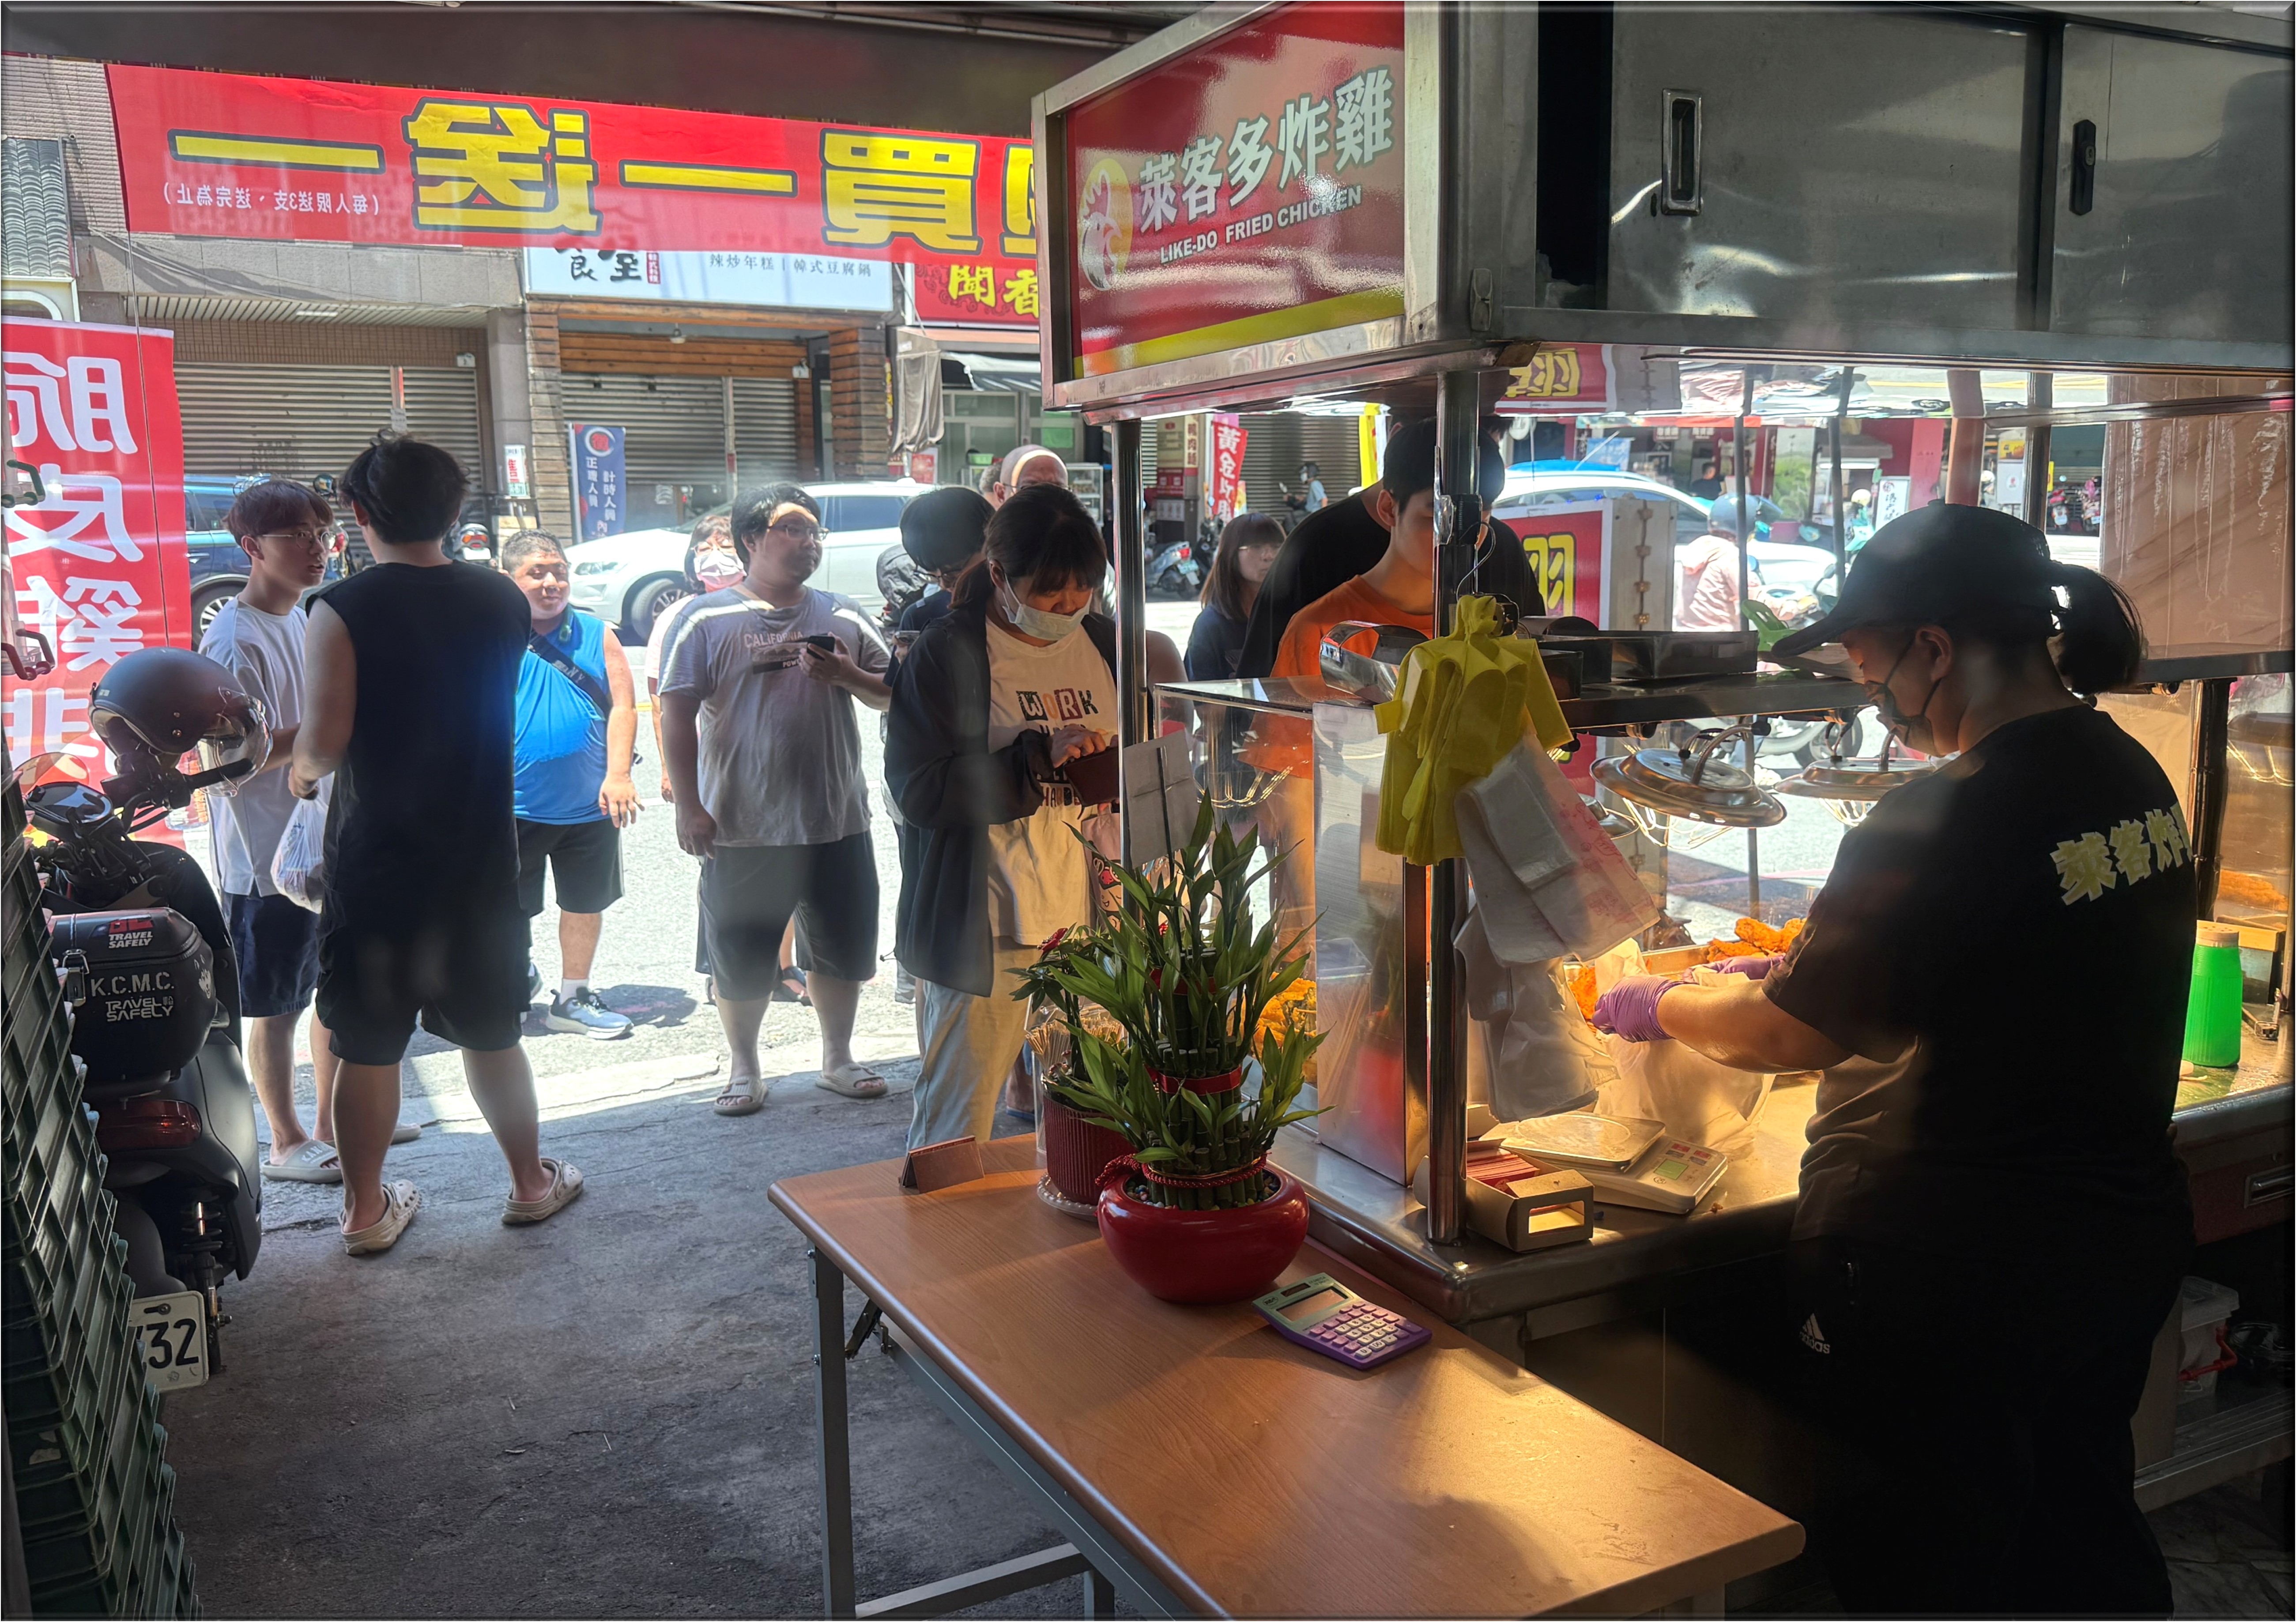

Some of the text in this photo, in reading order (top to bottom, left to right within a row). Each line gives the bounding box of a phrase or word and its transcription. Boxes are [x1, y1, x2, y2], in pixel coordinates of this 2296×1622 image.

[1139, 67, 1394, 234] 萊客多炸雞
[1160, 184, 1362, 264] LIKE-DO FRIED CHICKEN
[744, 631, 803, 648] CALIFORNIA
[783, 659, 800, 668] POWE
[1016, 688, 1099, 721] WORK
[109, 931, 153, 941] TRAVEL
[109, 938, 152, 948] SAFELY
[90, 971, 174, 997] K.C.M.C.
[105, 997, 162, 1012] TRAVEL
[106, 1006, 173, 1022] SAFELY
[136, 1318, 199, 1369] 32
